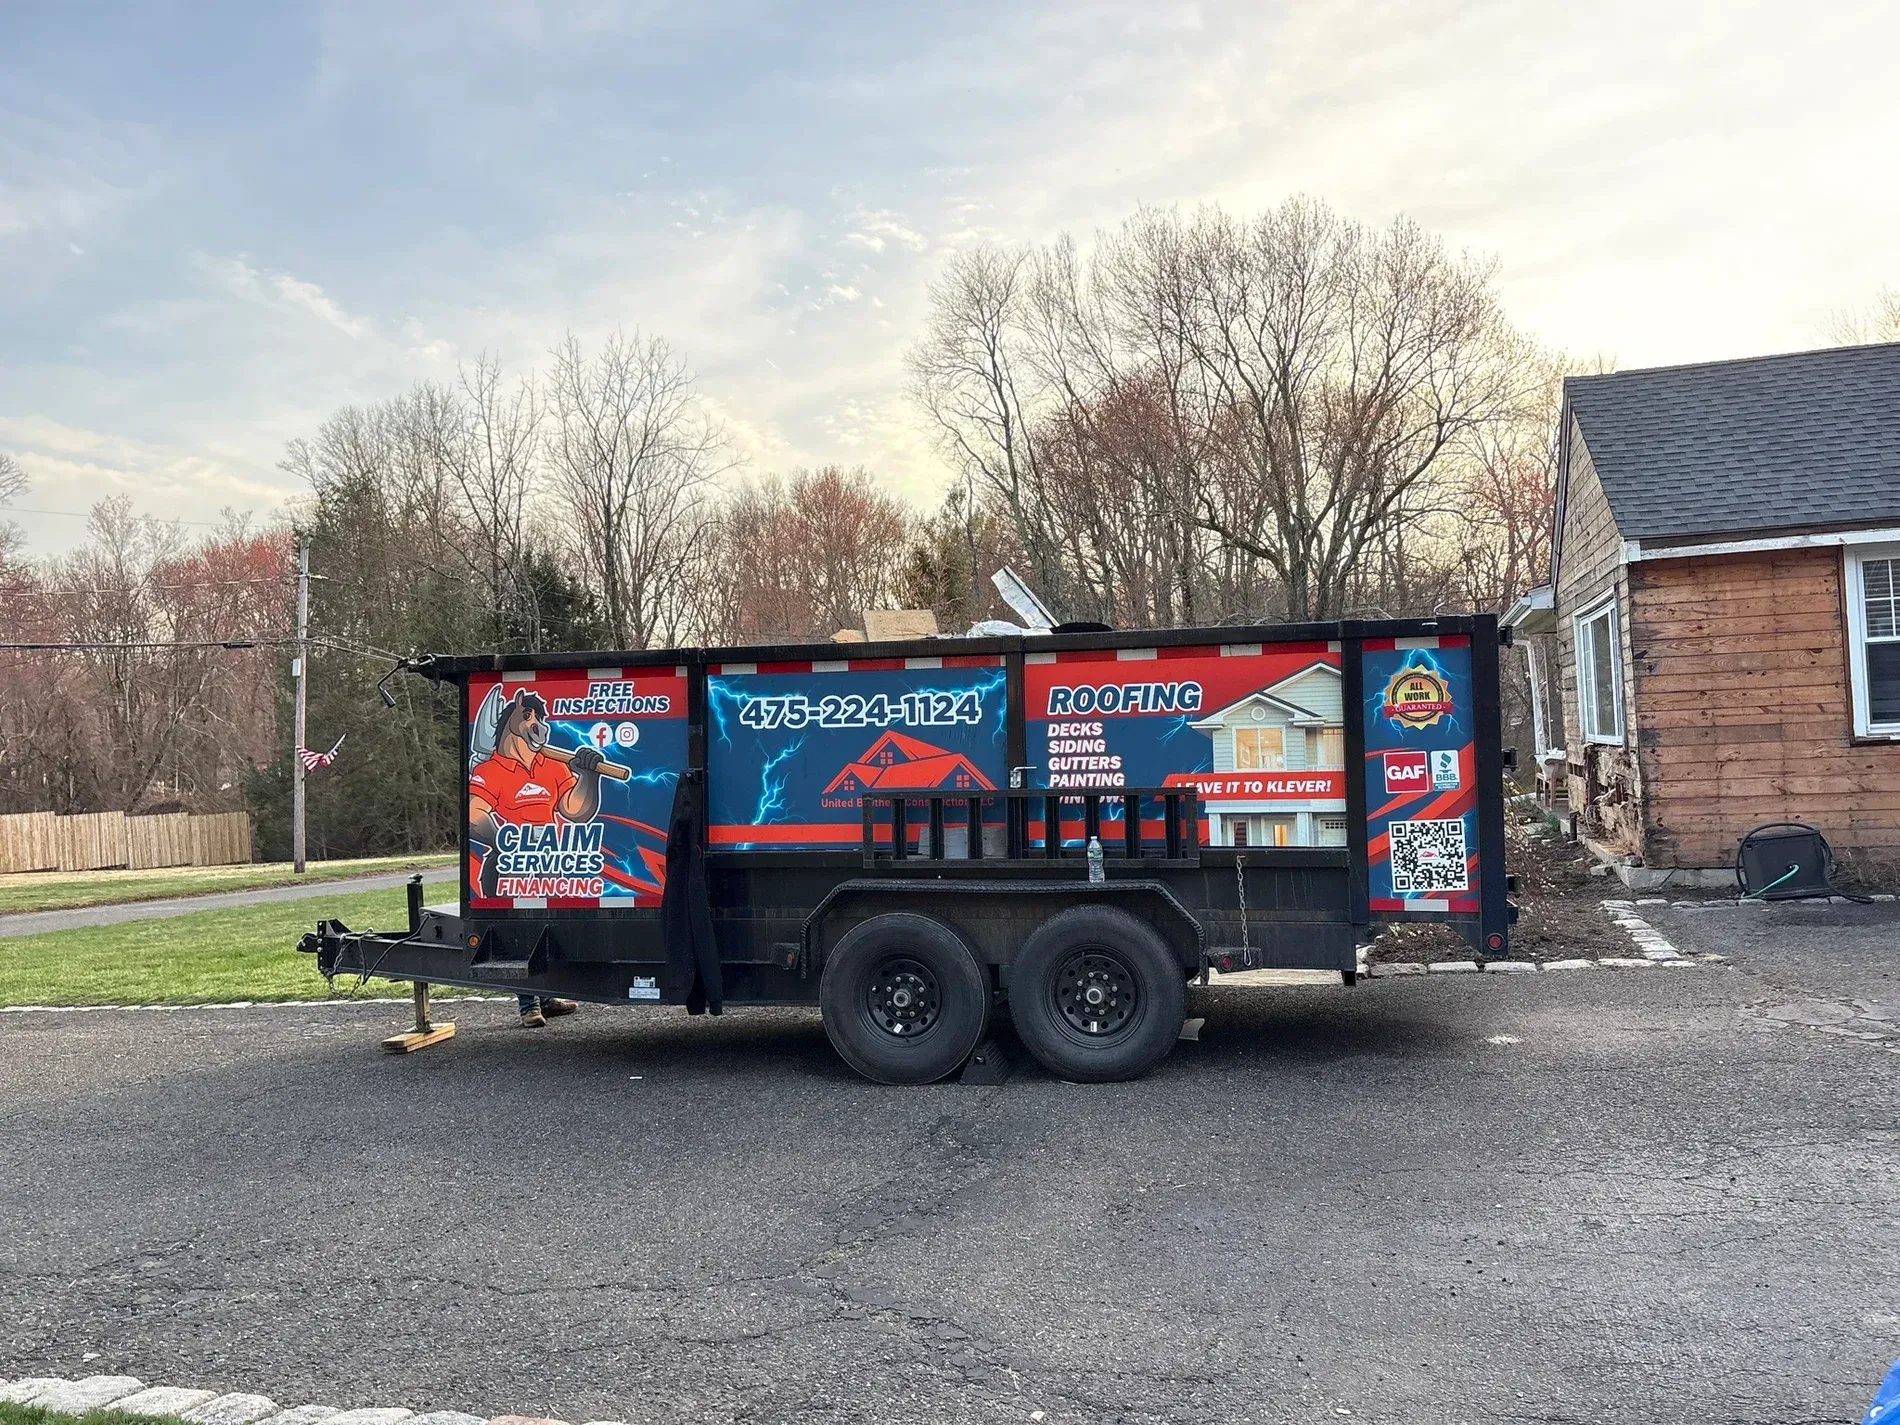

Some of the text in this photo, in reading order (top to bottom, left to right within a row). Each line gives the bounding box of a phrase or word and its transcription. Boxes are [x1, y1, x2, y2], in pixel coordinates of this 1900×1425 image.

[588, 682, 633, 699] FREE
[1410, 682, 1424, 691] ALL
[1047, 681, 1203, 715] ROOFING
[1404, 692, 1430, 701] WORK
[552, 696, 670, 716] INSPECTIONS
[739, 692, 982, 729] 475-224-1124
[1047, 722, 1103, 738] DECKS
[1048, 739, 1106, 754] SIDING
[1048, 756, 1122, 771] GUTTERS
[1049, 772, 1125, 788] PAINTING
[1386, 765, 1425, 780] GAF
[1436, 773, 1457, 782] BBB
[1226, 781, 1240, 793] IT
[1243, 781, 1263, 793] TO
[1266, 780, 1332, 793] KLEVER!
[821, 798, 853, 808] United
[856, 797, 895, 807] Bthe
[496, 823, 604, 853] CLAIM
[495, 853, 604, 874] SERVICES
[496, 877, 604, 897] FINANCING
